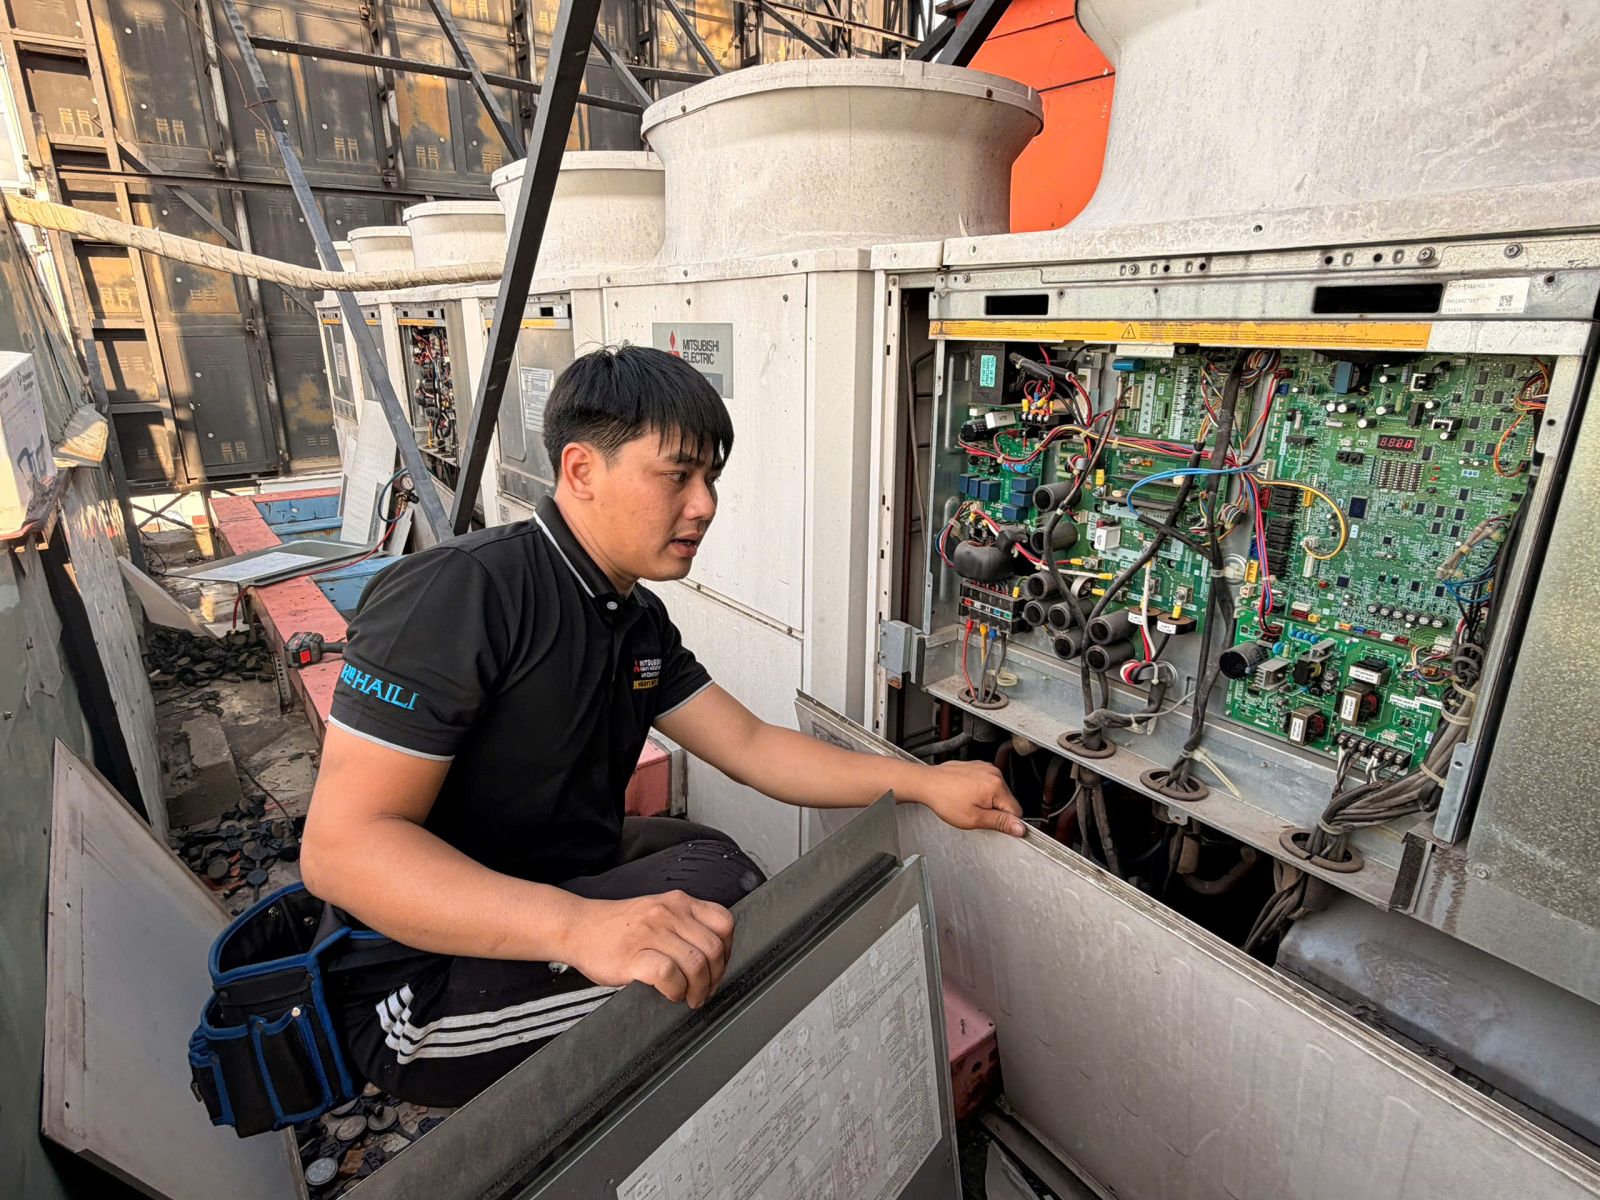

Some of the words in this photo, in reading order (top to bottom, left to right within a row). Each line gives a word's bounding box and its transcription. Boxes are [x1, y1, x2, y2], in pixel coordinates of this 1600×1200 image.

[683, 339, 719, 352] MITSUBISHI
[683, 352, 715, 365] ELECTRIC
[351, 670, 420, 711] HAILI
